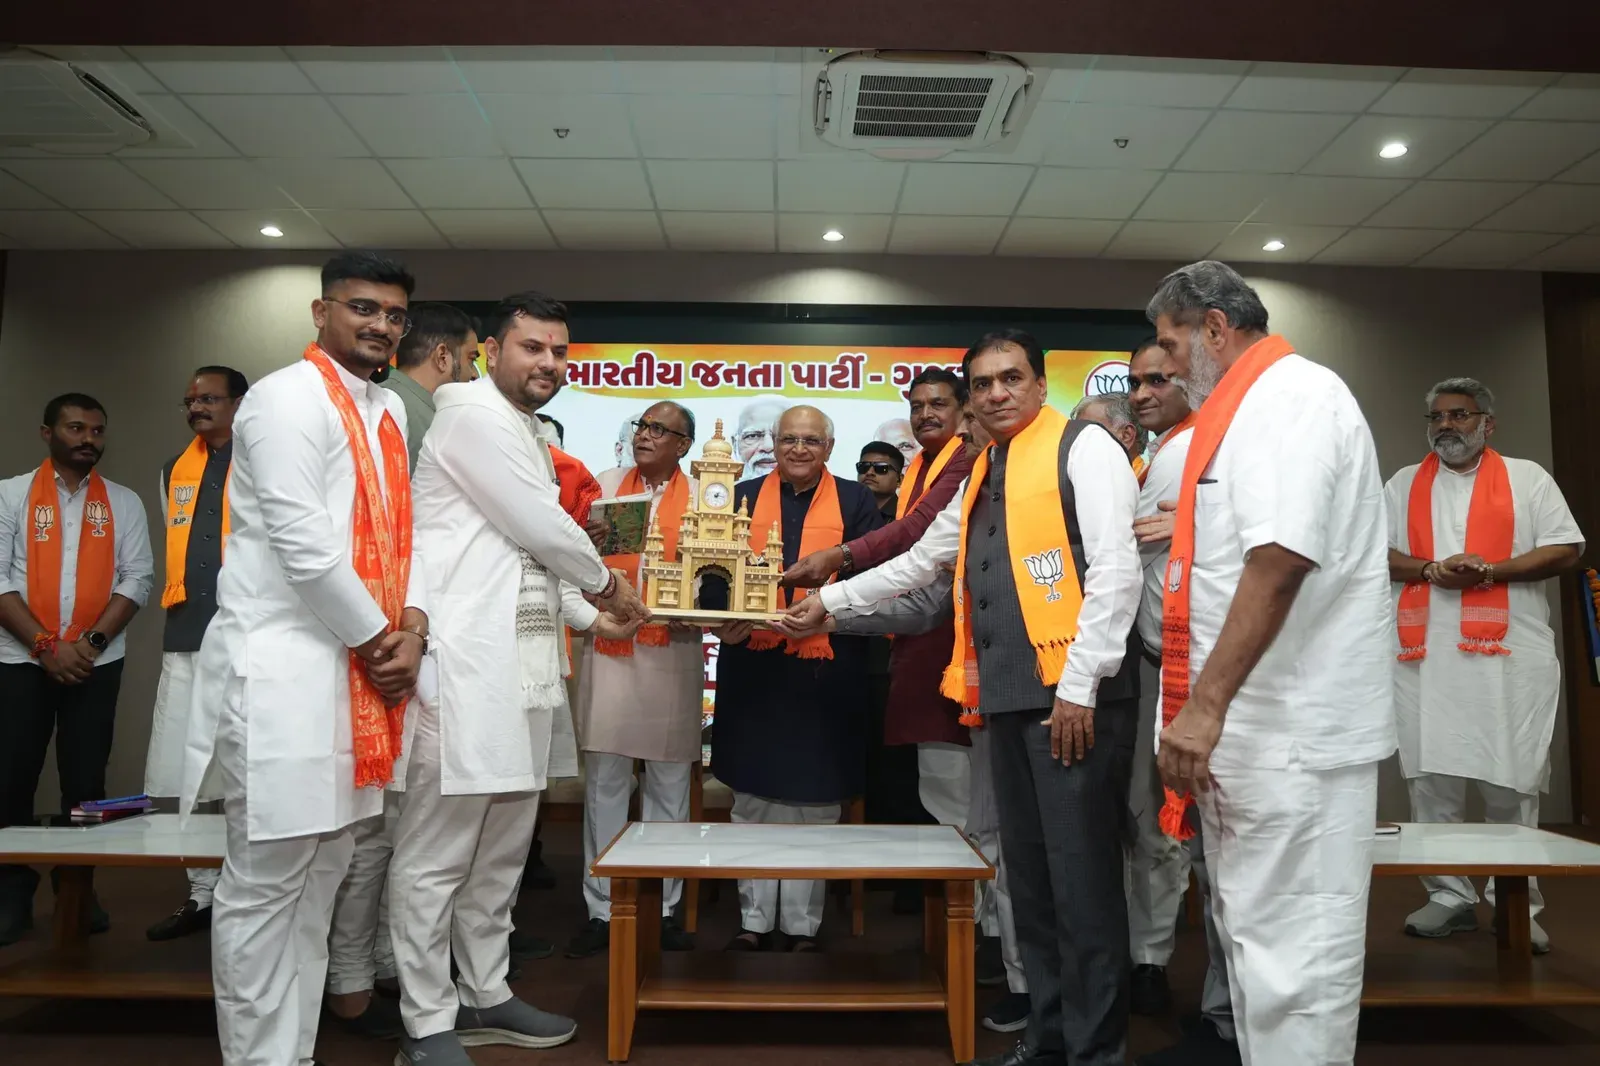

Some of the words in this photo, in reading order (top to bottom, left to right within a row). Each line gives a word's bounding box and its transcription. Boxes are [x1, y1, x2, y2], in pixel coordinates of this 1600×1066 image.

[567, 352, 682, 387] ભારતીય
[691, 362, 782, 388] જનતા
[791, 355, 865, 389] પાર્ટી
[173, 517, 187, 525] BJP
